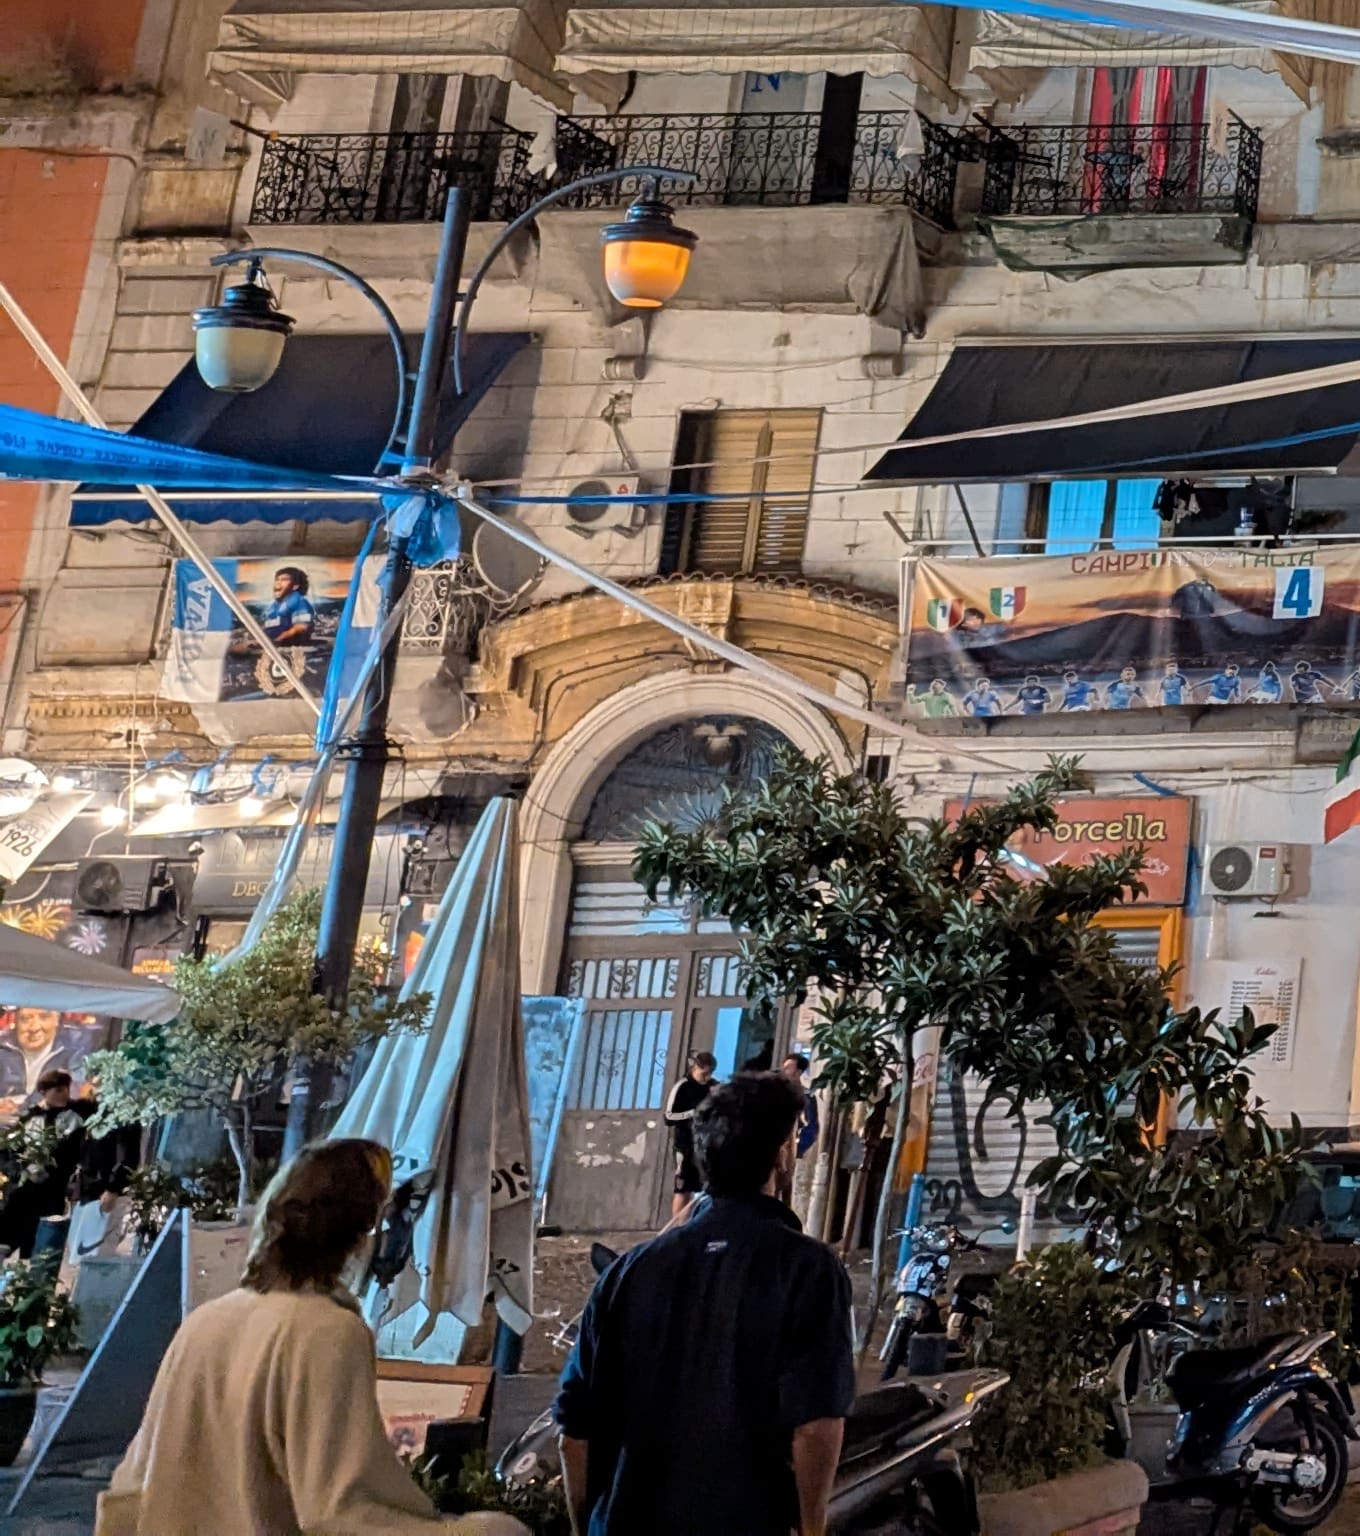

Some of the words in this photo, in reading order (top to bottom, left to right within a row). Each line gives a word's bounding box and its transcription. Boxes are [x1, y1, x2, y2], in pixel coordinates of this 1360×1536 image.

[1003, 593, 1015, 608] 2
[1282, 568, 1312, 617] 4
[940, 604, 948, 618] 1
[0, 828, 34, 857] 1926
